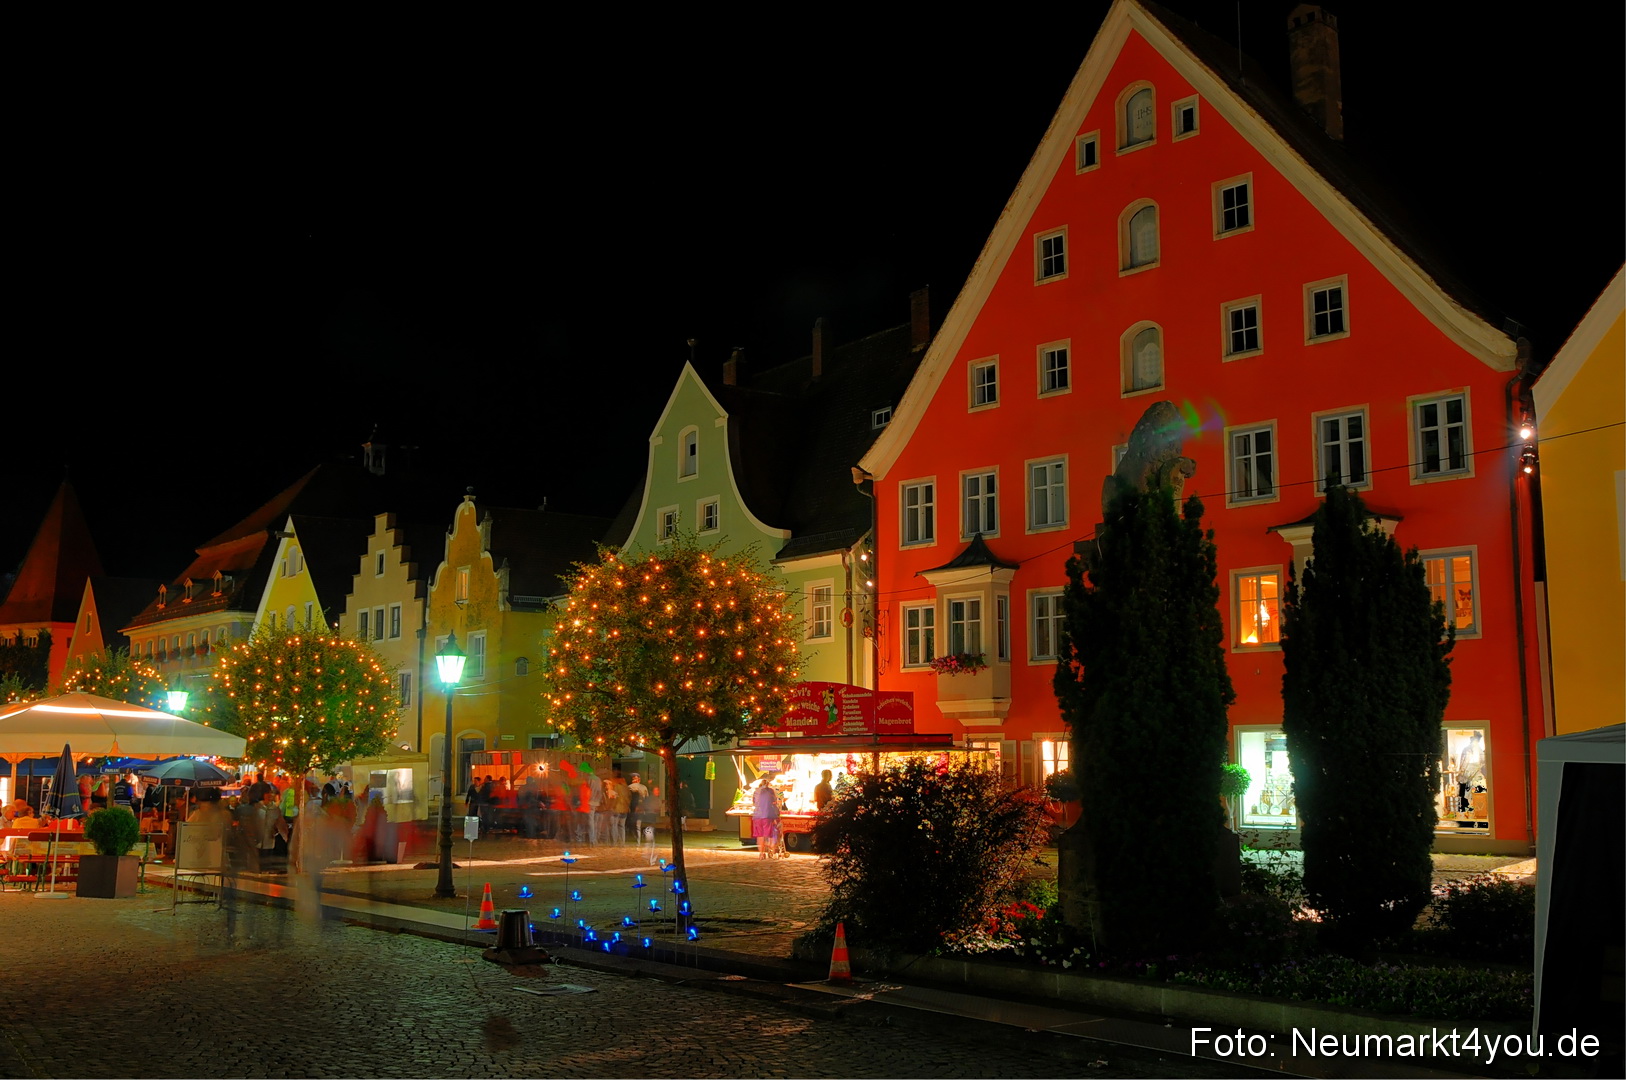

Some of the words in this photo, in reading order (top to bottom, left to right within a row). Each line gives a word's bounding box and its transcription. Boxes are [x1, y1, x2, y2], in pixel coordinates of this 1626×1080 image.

[800, 700, 821, 713] weiche
[786, 717, 818, 726] Mandeln
[879, 718, 911, 726] Magenbrot
